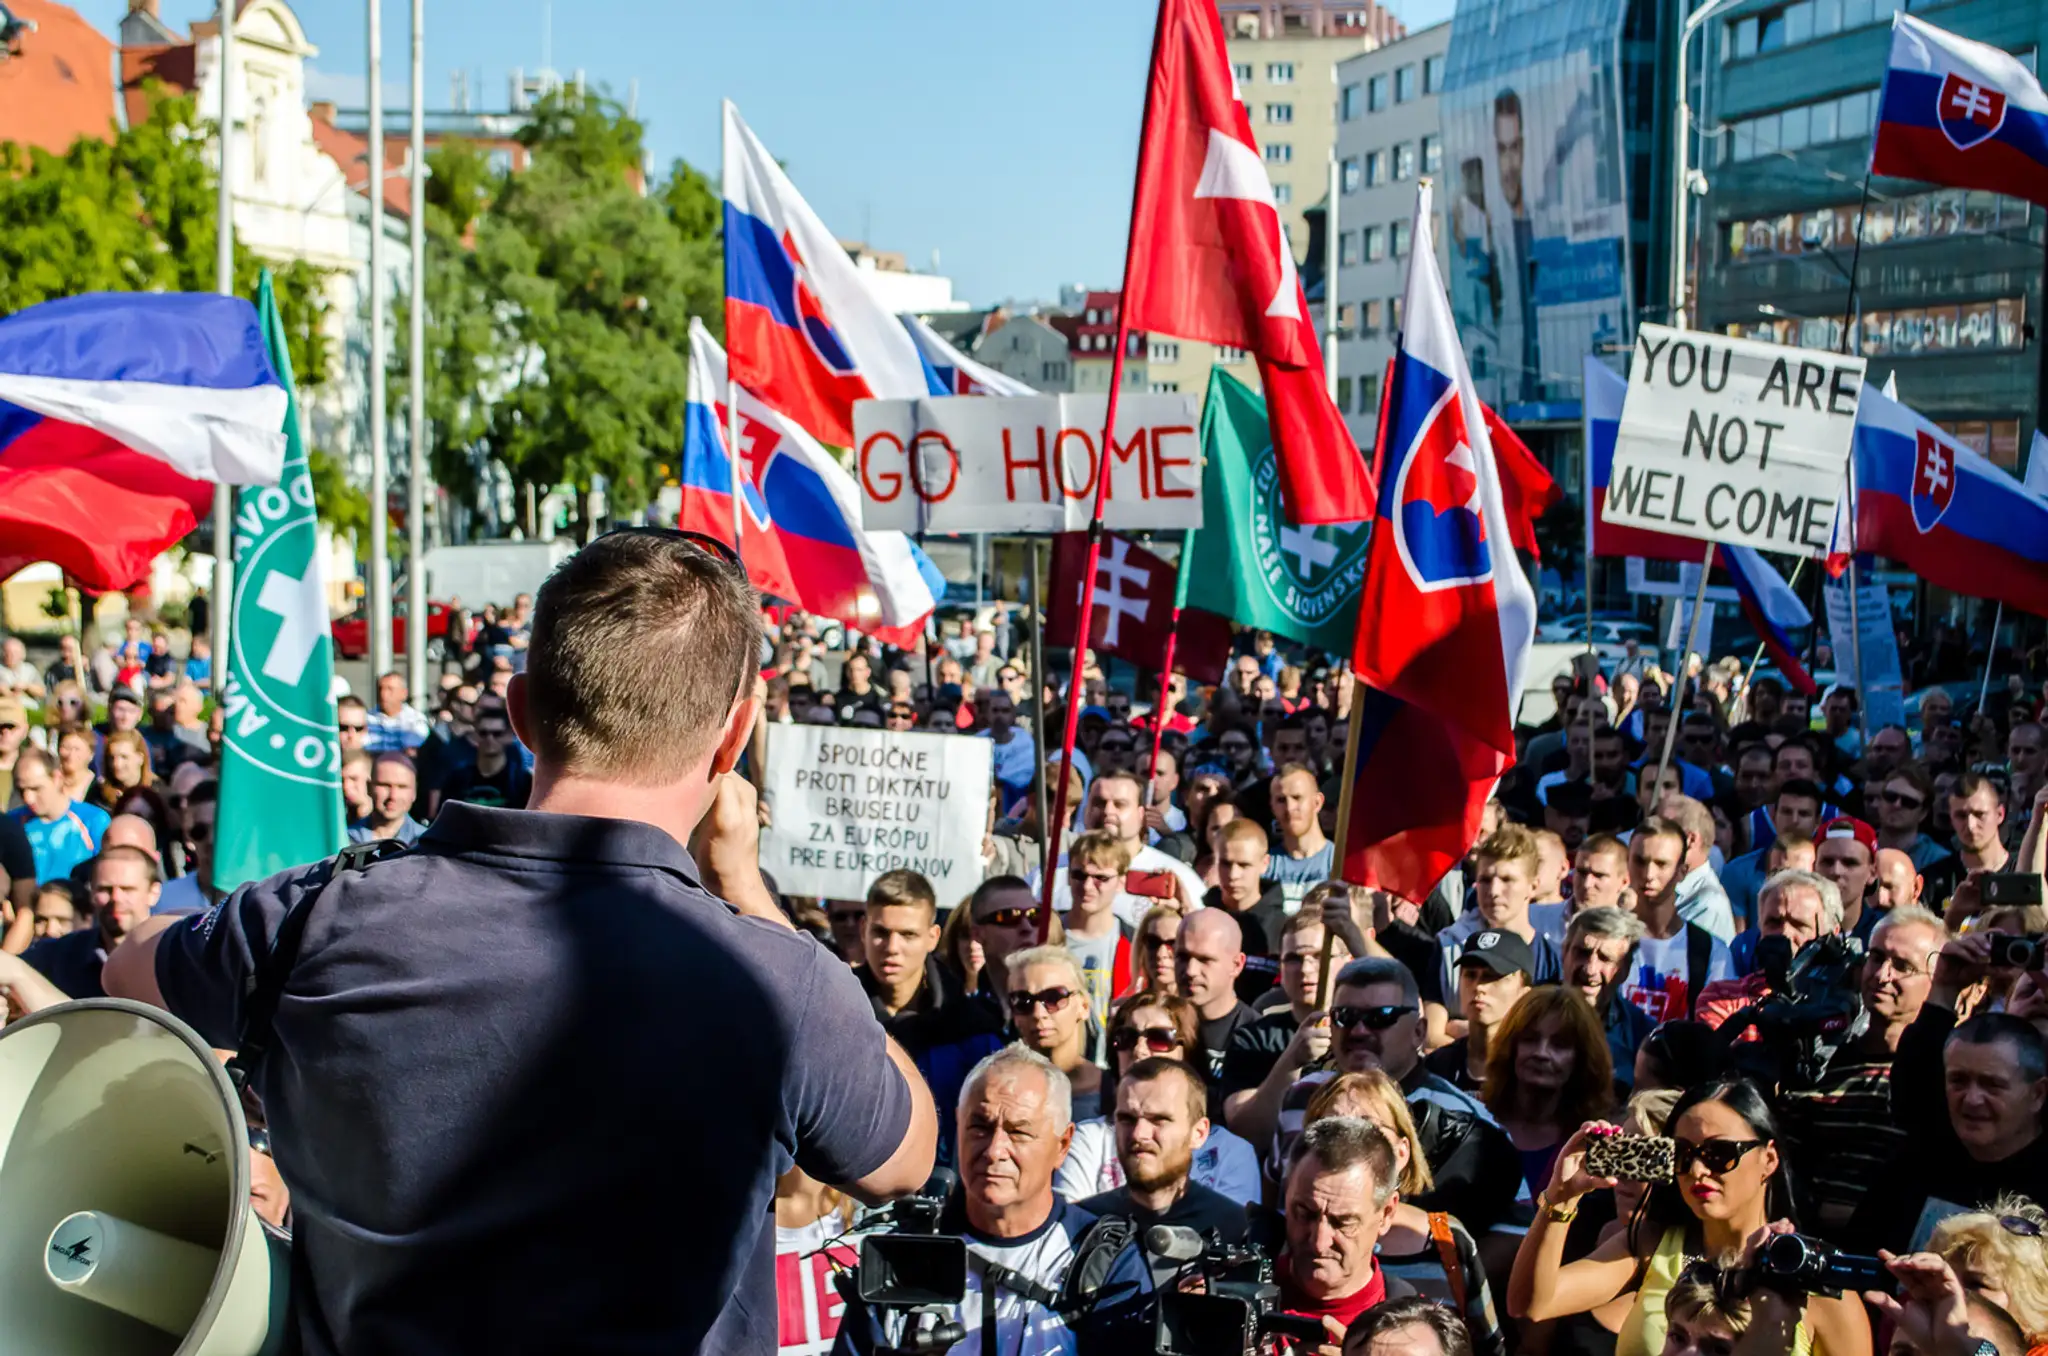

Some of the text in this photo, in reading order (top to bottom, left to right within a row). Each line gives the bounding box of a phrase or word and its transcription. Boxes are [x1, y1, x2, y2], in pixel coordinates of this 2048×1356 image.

[1639, 334, 1862, 416] YOU ARE
[1682, 409, 1785, 470] NOT
[859, 430, 959, 503] GO
[1002, 425, 1195, 502] HOME
[1608, 466, 1834, 549] WELCOME
[818, 742, 928, 771] SPOLOČNE
[795, 769, 951, 800] PROTI DIKTÁTU
[826, 797, 920, 823] BRUSELU
[808, 823, 929, 851] ZA EURÓPU
[790, 847, 827, 868] PRE
